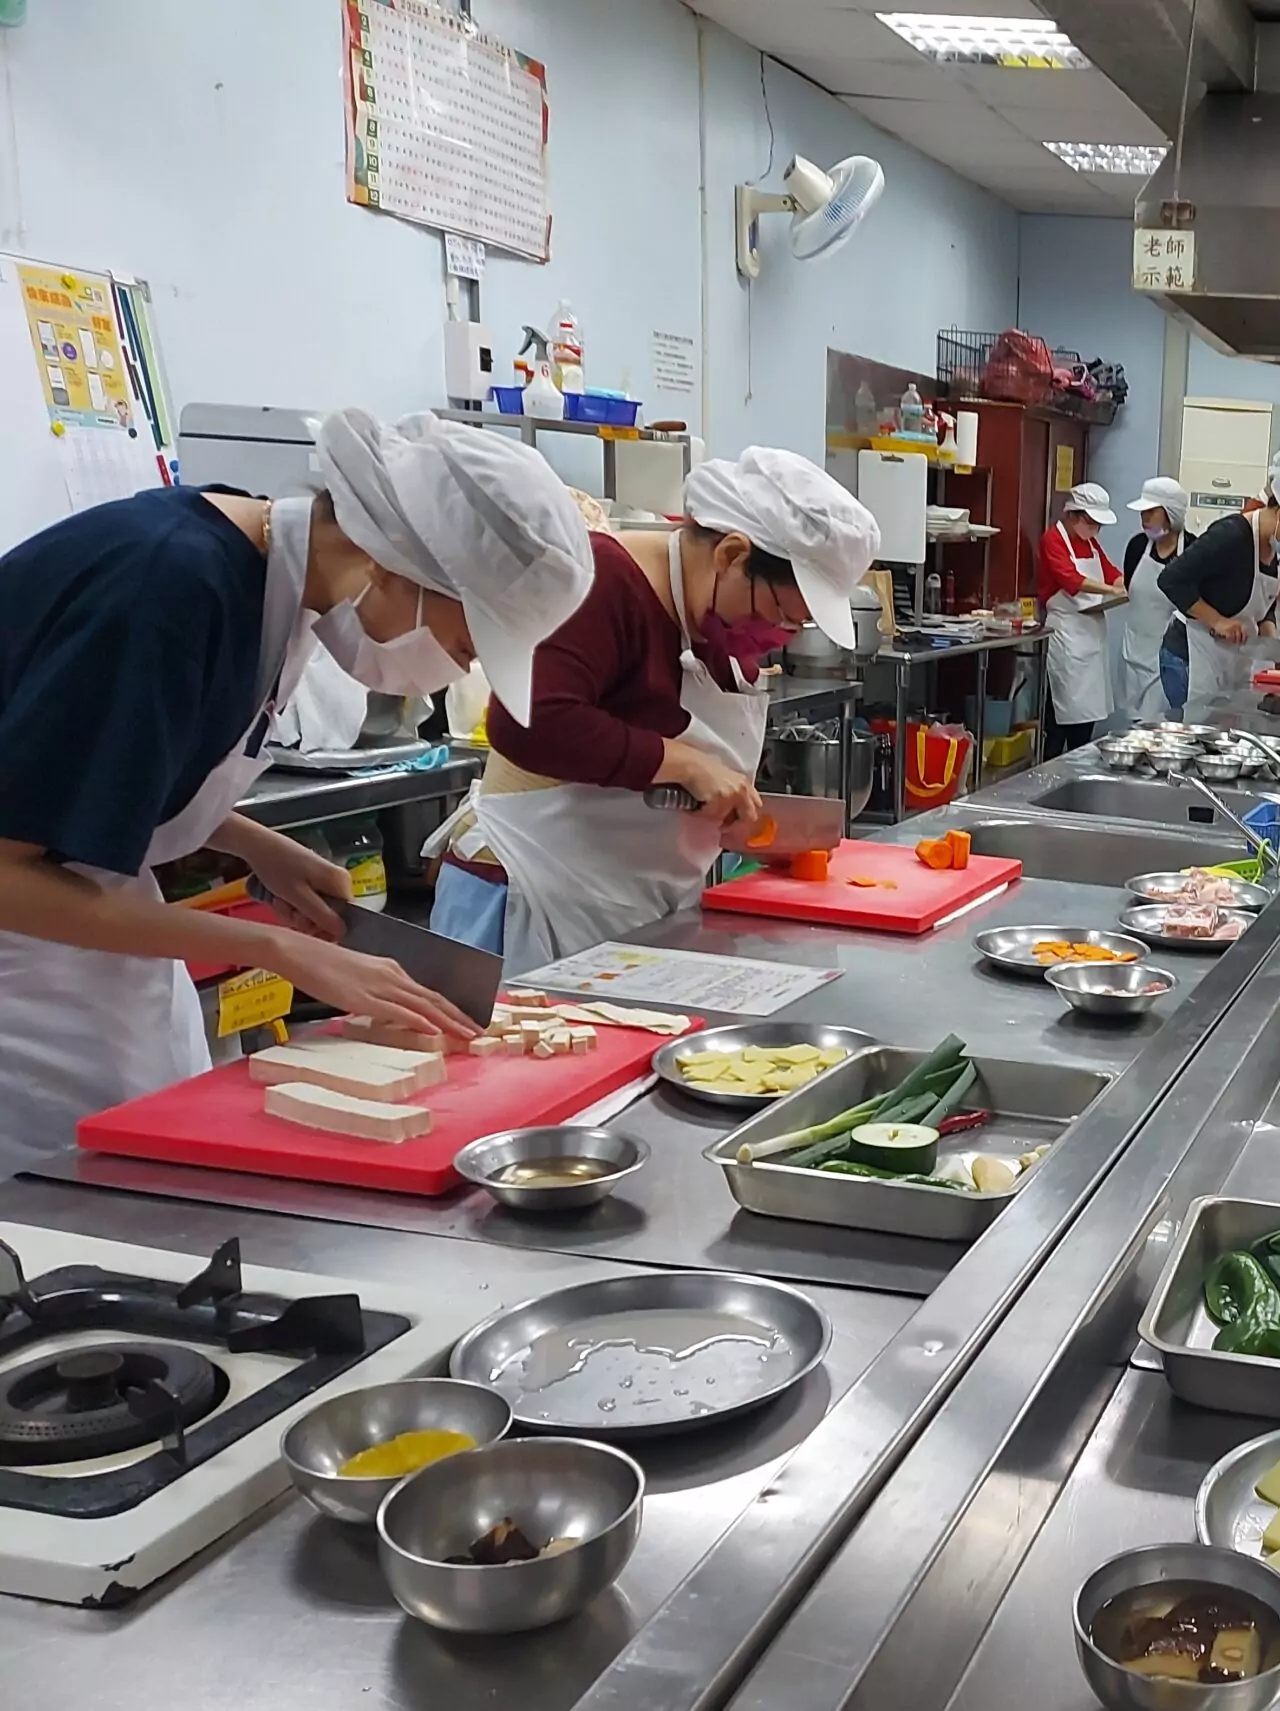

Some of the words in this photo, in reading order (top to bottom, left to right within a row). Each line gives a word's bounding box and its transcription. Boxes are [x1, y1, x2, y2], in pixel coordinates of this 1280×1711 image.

[1143, 235, 1185, 259] 老師
[1142, 265, 1185, 288] 示範
[541, 364, 549, 377] 6
